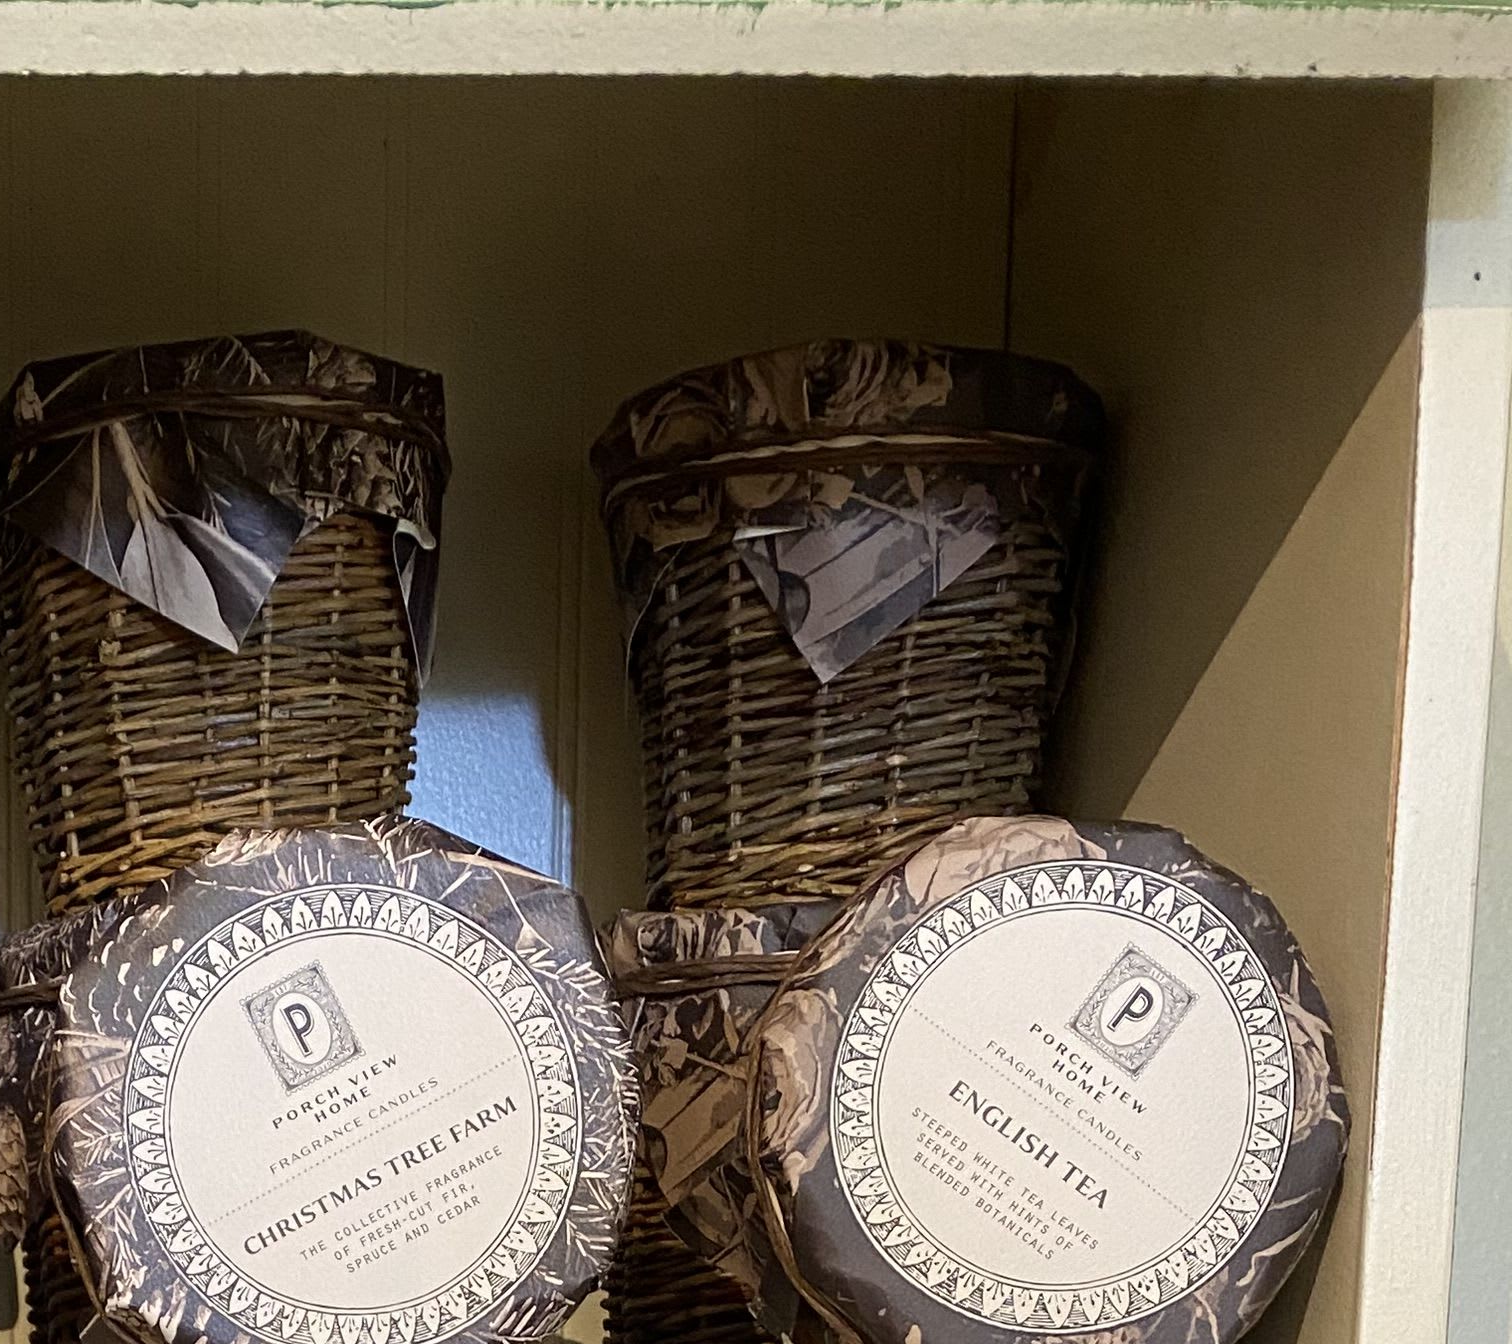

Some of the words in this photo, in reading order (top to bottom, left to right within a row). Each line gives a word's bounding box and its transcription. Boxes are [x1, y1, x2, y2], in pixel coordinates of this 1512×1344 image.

[281, 1003, 314, 1057] P
[1106, 983, 1154, 1033] P
[272, 1085, 341, 1130] PORCH
[348, 1054, 398, 1087] VIEW
[314, 1086, 372, 1124] HOME
[986, 1039, 1074, 1110] FRAGRANCE
[1077, 1107, 1144, 1162] CANDLES
[1029, 1022, 1094, 1076] PORCH
[1101, 1074, 1148, 1116] VIEW
[1051, 1059, 1107, 1105] HOME
[269, 1116, 364, 1175] FRAGRANCE
[368, 1076, 439, 1121] CANDLES
[948, 1079, 1059, 1170] ENGLISH
[1061, 1160, 1109, 1210] TEA
[242, 1168, 383, 1256] CHRISTMAS
[383, 1134, 447, 1177] TREE
[448, 1095, 518, 1144] FARM
[299, 1239, 328, 1261] THE
[334, 1190, 419, 1242] COLLECTIVE
[425, 1144, 503, 1193] FRAGRANCE
[911, 1106, 969, 1153] STEEPED
[973, 1151, 1015, 1188] WHITE
[1020, 1186, 1045, 1211] TEA
[1050, 1209, 1100, 1251] LEAVES
[913, 1151, 971, 1198] BLENDED
[974, 1196, 1055, 1261] BOTANICALS
[916, 1132, 966, 1173] SERVED
[969, 1171, 1004, 1202] WITH
[1008, 1199, 1050, 1235] HINTS
[1055, 1234, 1075, 1252] OF
[333, 1244, 352, 1261] OF
[359, 1200, 434, 1248] FRESH-CUT
[345, 1239, 398, 1274] SPRUCE
[404, 1222, 431, 1244] AND
[436, 1195, 481, 1225] CEDAR
